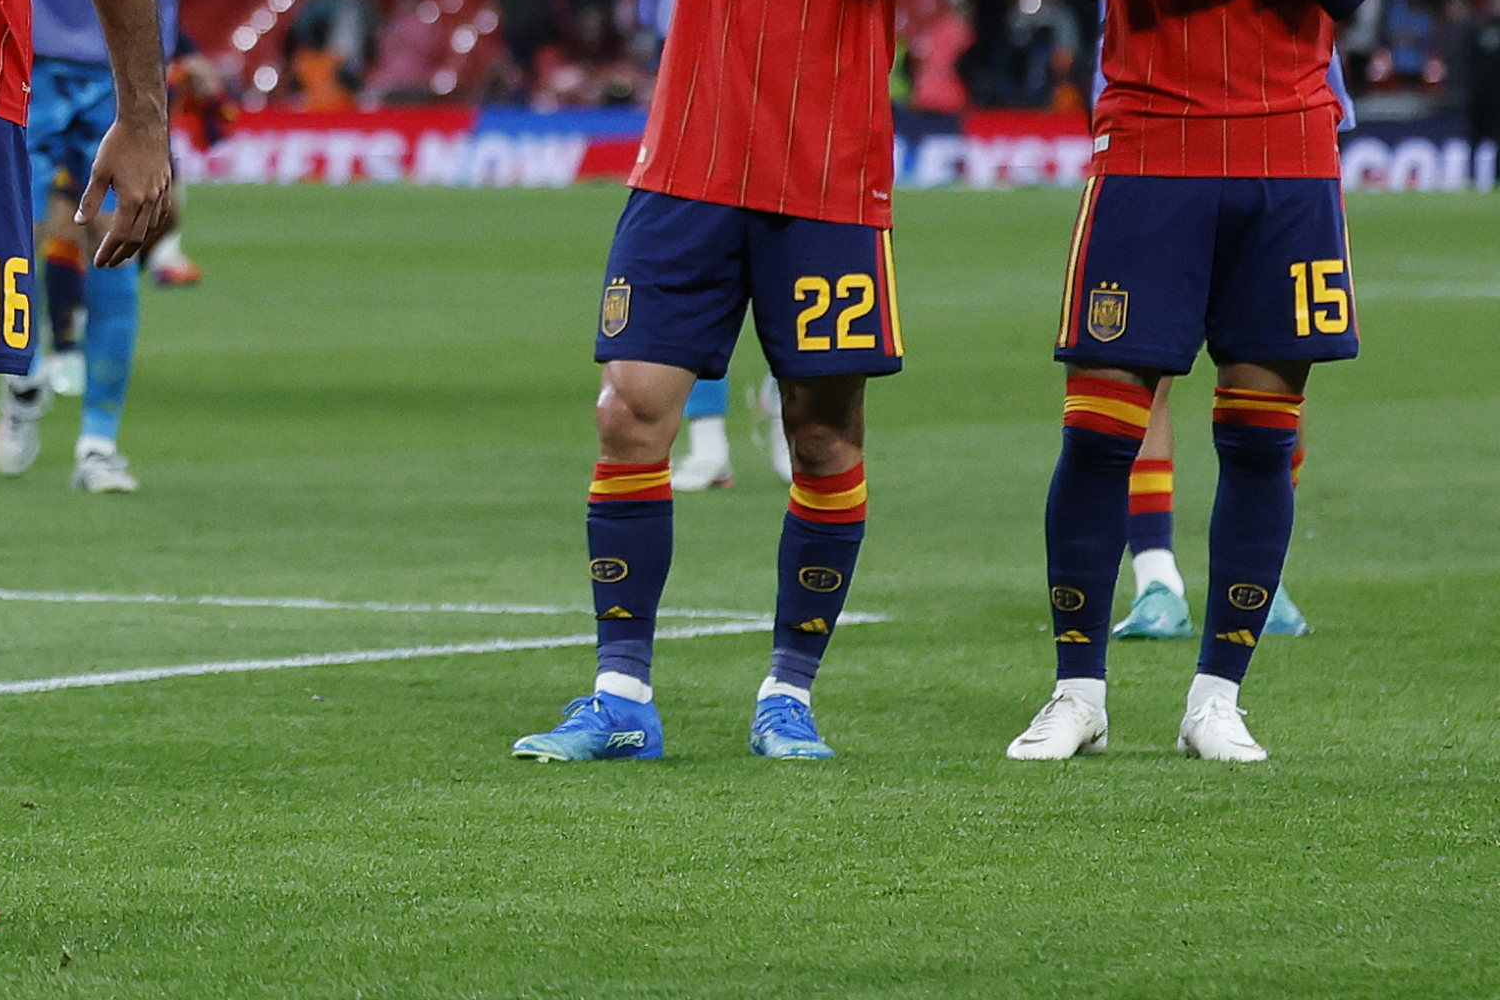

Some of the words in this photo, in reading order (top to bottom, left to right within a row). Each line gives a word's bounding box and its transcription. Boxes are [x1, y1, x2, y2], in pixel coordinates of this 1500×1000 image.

[413, 130, 587, 188] NOW
[793, 273, 877, 351] 22
[1289, 259, 1350, 337] 15
